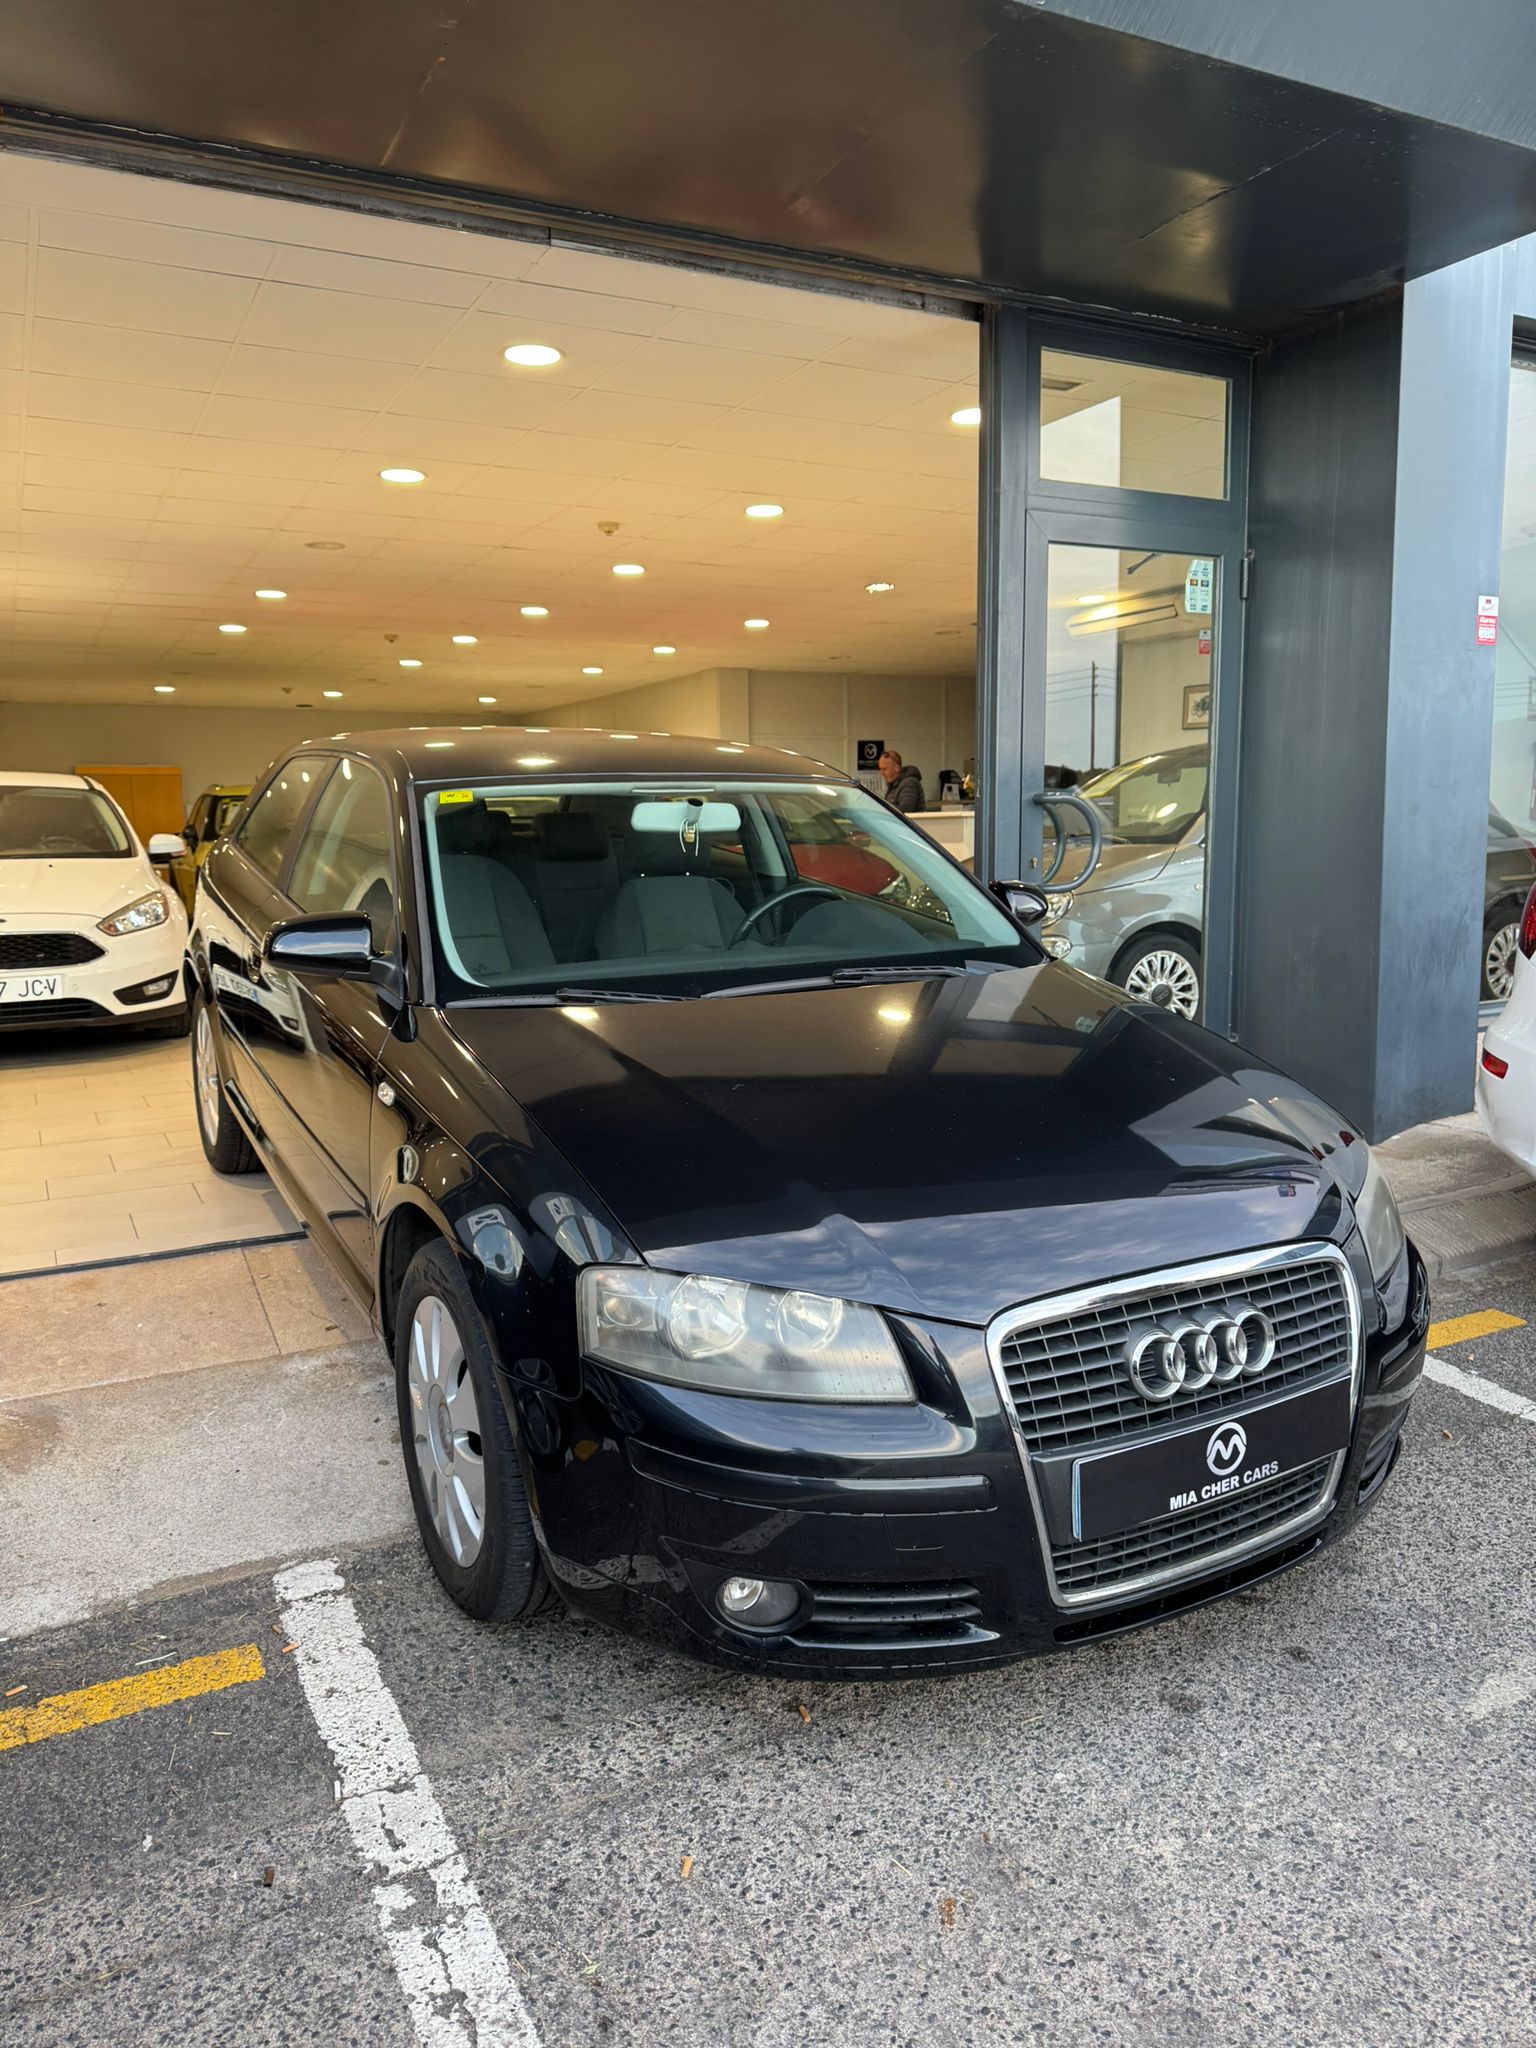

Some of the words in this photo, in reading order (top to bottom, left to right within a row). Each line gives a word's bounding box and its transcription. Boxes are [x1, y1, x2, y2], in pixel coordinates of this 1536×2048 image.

[1169, 1490, 1198, 1511] MIA
[1201, 1475, 1240, 1499] CHER
[1243, 1460, 1279, 1484] CARS
